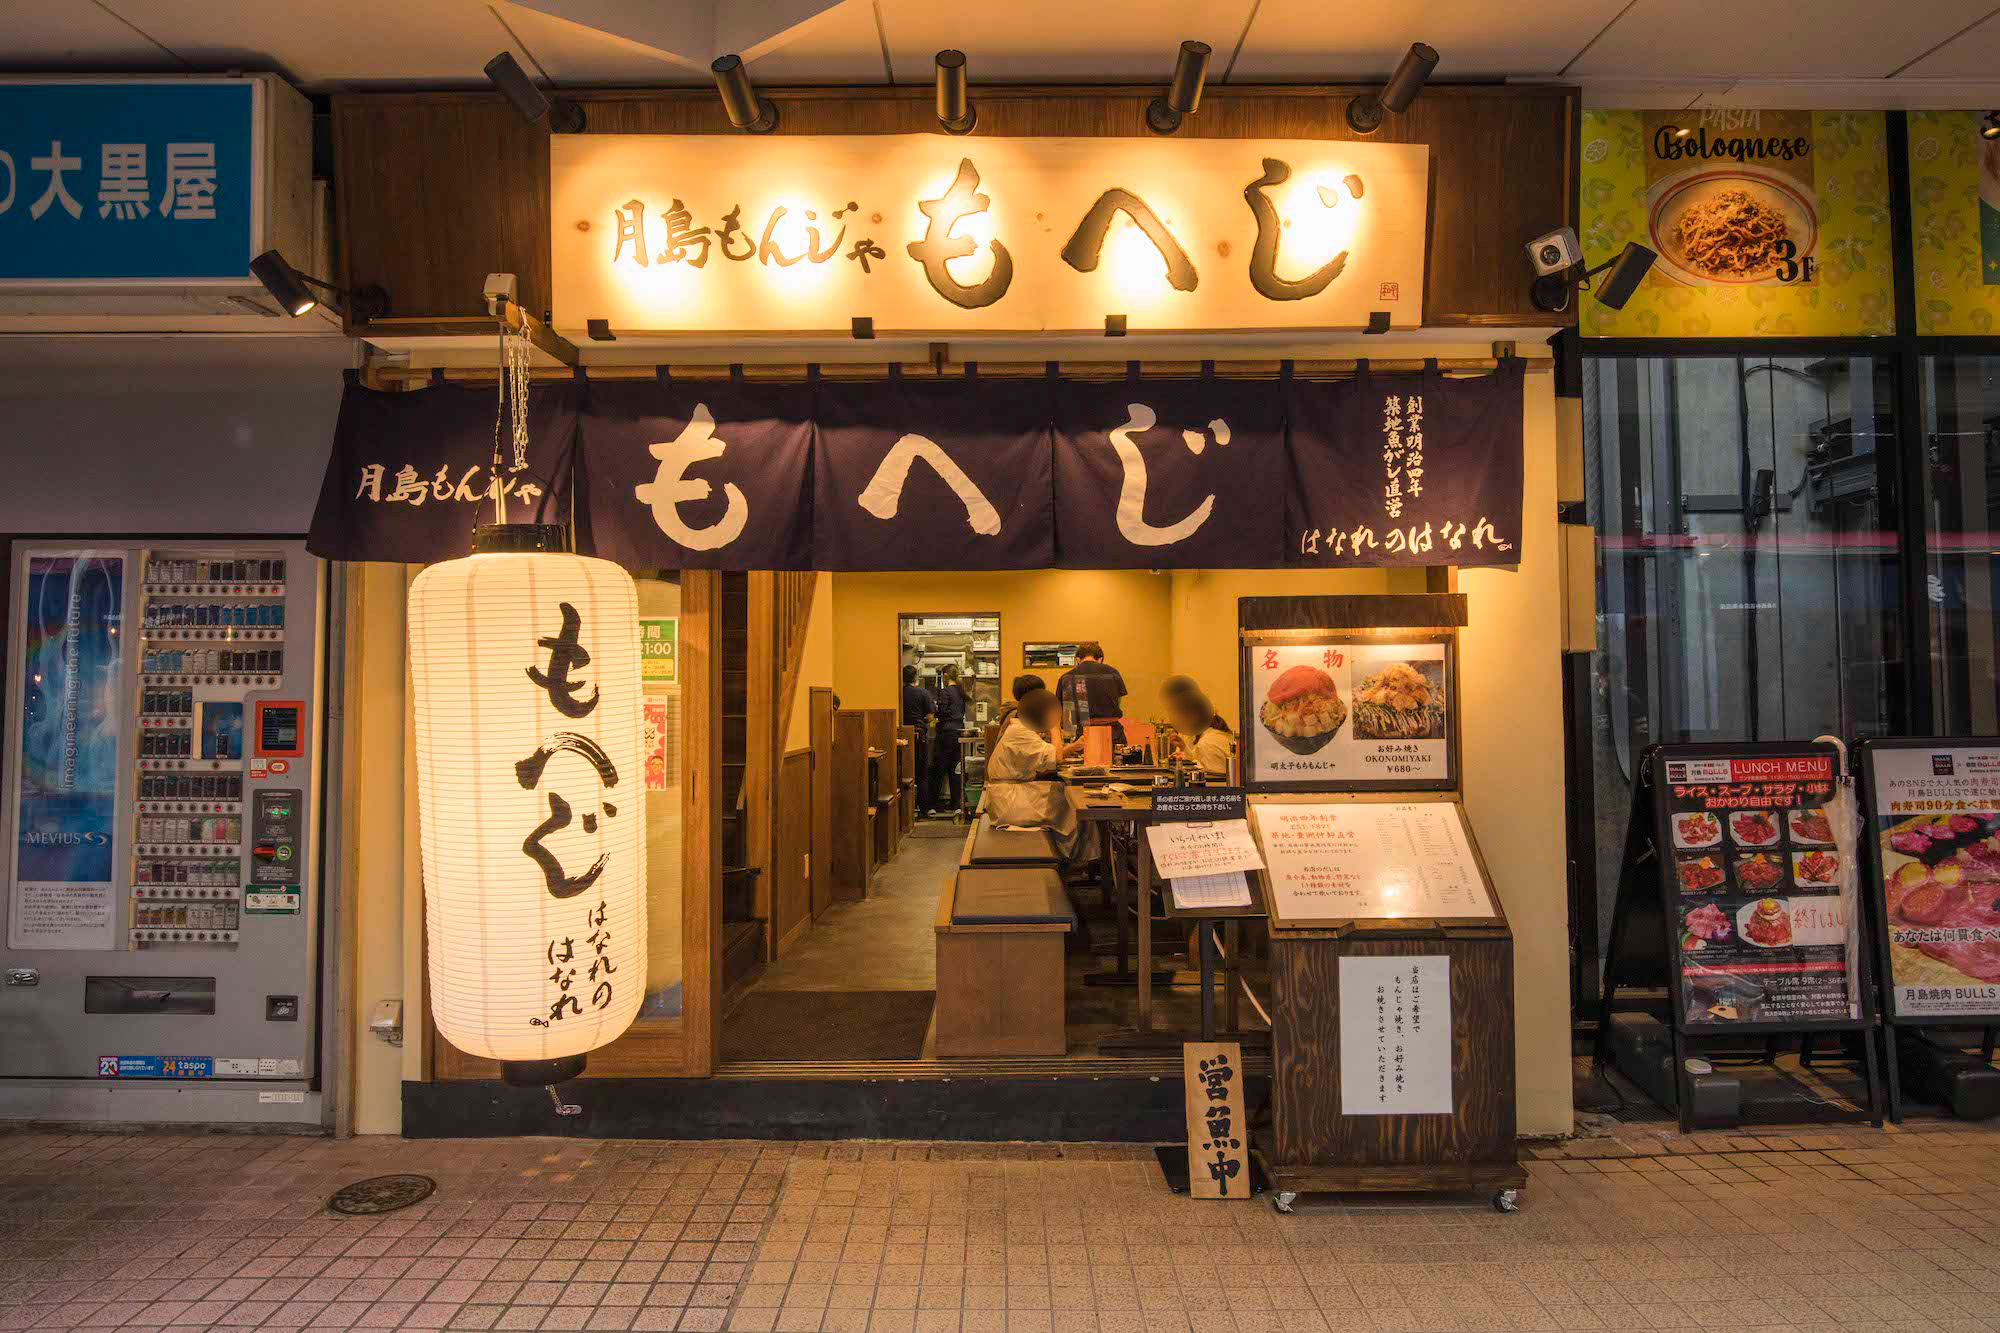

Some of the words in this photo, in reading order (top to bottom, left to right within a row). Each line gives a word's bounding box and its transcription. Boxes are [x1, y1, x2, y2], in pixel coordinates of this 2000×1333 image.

[1654, 125, 1811, 163] Bolognese
[0, 140, 218, 220] 大黒屋
[613, 198, 886, 274] 月島もんじゃ
[906, 157, 1365, 310] もへじ
[1775, 239, 1815, 283] 3F
[1406, 395, 1424, 497] 創業明治四年
[354, 463, 543, 507] 月島もんじゃ
[634, 402, 1231, 552] もへじ
[65, 593, 82, 643] future
[65, 645, 80, 674] the
[60, 679, 81, 790] imagineering
[513, 601, 620, 900] もへじ
[1377, 744, 1419, 753] お好み焼き
[1270, 761, 1336, 771] 明太子もちもんじゃ
[1365, 754, 1431, 763] OKONOMIYAKI
[1733, 762, 1781, 774] LUNCH
[1785, 760, 1828, 773] MENU
[25, 831, 81, 845] MEVIUS
[585, 901, 618, 1010] はなれの
[1893, 928, 2000, 942] あなたは何貫食べ
[546, 936, 583, 1021] はなれ
[1410, 965, 1421, 1033] 当店はご希望で
[1905, 989, 1952, 1001] 月島焼肉
[1955, 988, 1996, 999] BULLS
[178, 1060, 206, 1071] taspo
[1376, 985, 1387, 1103] お焼きさせていただきます
